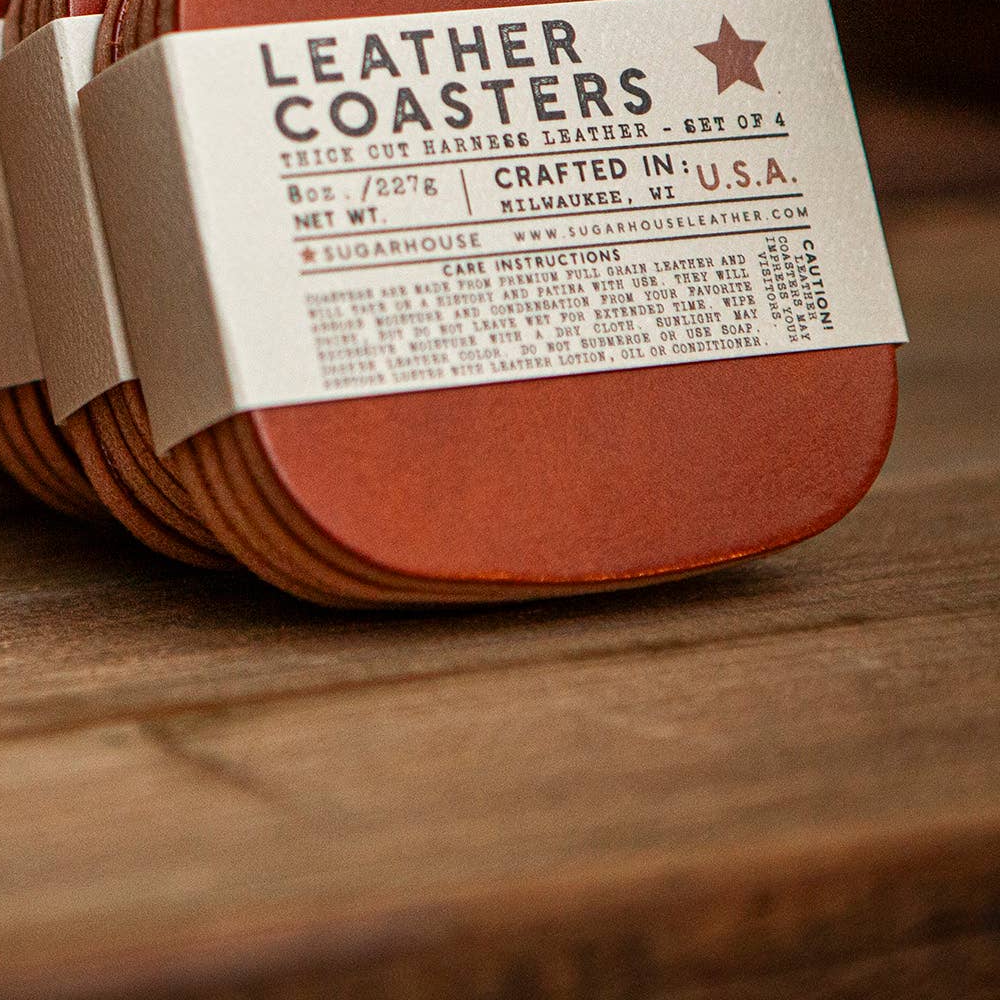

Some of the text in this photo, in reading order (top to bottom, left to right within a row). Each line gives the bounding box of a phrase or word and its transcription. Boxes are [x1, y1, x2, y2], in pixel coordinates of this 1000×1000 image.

[261, 20, 581, 88] LEATHER
[275, 69, 652, 143] COASTERS
[280, 147, 354, 169] THICK
[368, 142, 409, 160] CUT
[423, 132, 530, 156] HARNESS
[542, 123, 649, 146] LEATHER
[684, 116, 726, 135] SET
[737, 113, 764, 131] OF
[775, 112, 786, 128] 4
[495, 153, 798, 192] CRAFTED IN: U.S.A.
[293, 207, 387, 231] NET WT.
[501, 186, 676, 214] MILWAUKEE, WI
[514, 207, 809, 242] WWW.SUGARHOUSELEATHER.COM
[323, 232, 482, 262] SUGARHOUSE
[442, 249, 621, 278] CARE INSTRUCTIONS
[457, 278, 492, 291] FROM
[499, 272, 559, 287] PREMIUM
[566, 268, 601, 281] FULL
[607, 263, 648, 277] GRAIN
[654, 257, 715, 273] LEATHER
[721, 254, 747, 267] AND
[503, 288, 529, 301] AND
[537, 283, 585, 298] PATINA
[592, 279, 625, 293] WITH
[632, 276, 666, 289] USE.
[674, 271, 708, 285] THEY
[716, 268, 750, 281] WILL
[758, 251, 781, 327] VISITORS.
[765, 236, 798, 342] IMPRESS YOUR
[778, 236, 811, 341] COASTERS MAY
[795, 255, 818, 320] LEATHER
[803, 240, 834, 330] CAUTION!
[439, 323, 463, 336] NOT
[473, 318, 517, 333] LEAVE
[525, 314, 551, 327] WET
[560, 311, 586, 323] FOR
[594, 303, 665, 320] EXTENDED
[672, 299, 713, 313] TIME.
[722, 295, 756, 308] WIPE
[454, 307, 480, 320] AND
[491, 297, 590, 316] CONDENSATION
[600, 293, 635, 305] FROM
[644, 289, 678, 302] YOUR
[687, 281, 753, 297] FAVORITE
[489, 331, 523, 345] WITH
[536, 330, 544, 340] A
[555, 326, 581, 338] DRY
[593, 320, 642, 334] CLOTH.
[656, 312, 722, 328] SUNLIGHT
[733, 309, 758, 321] MAY
[521, 344, 537, 356] DO
[547, 341, 570, 353] NOT
[581, 333, 651, 350] SUBMERGE
[660, 330, 678, 342] OR
[686, 327, 713, 340] USE
[721, 323, 761, 336] SOAP.
[490, 357, 552, 373] LEATHER
[558, 351, 615, 366] LOTION,
[621, 348, 646, 360] OIL
[650, 345, 667, 358] OR
[672, 337, 768, 354] CONDITIONER.
